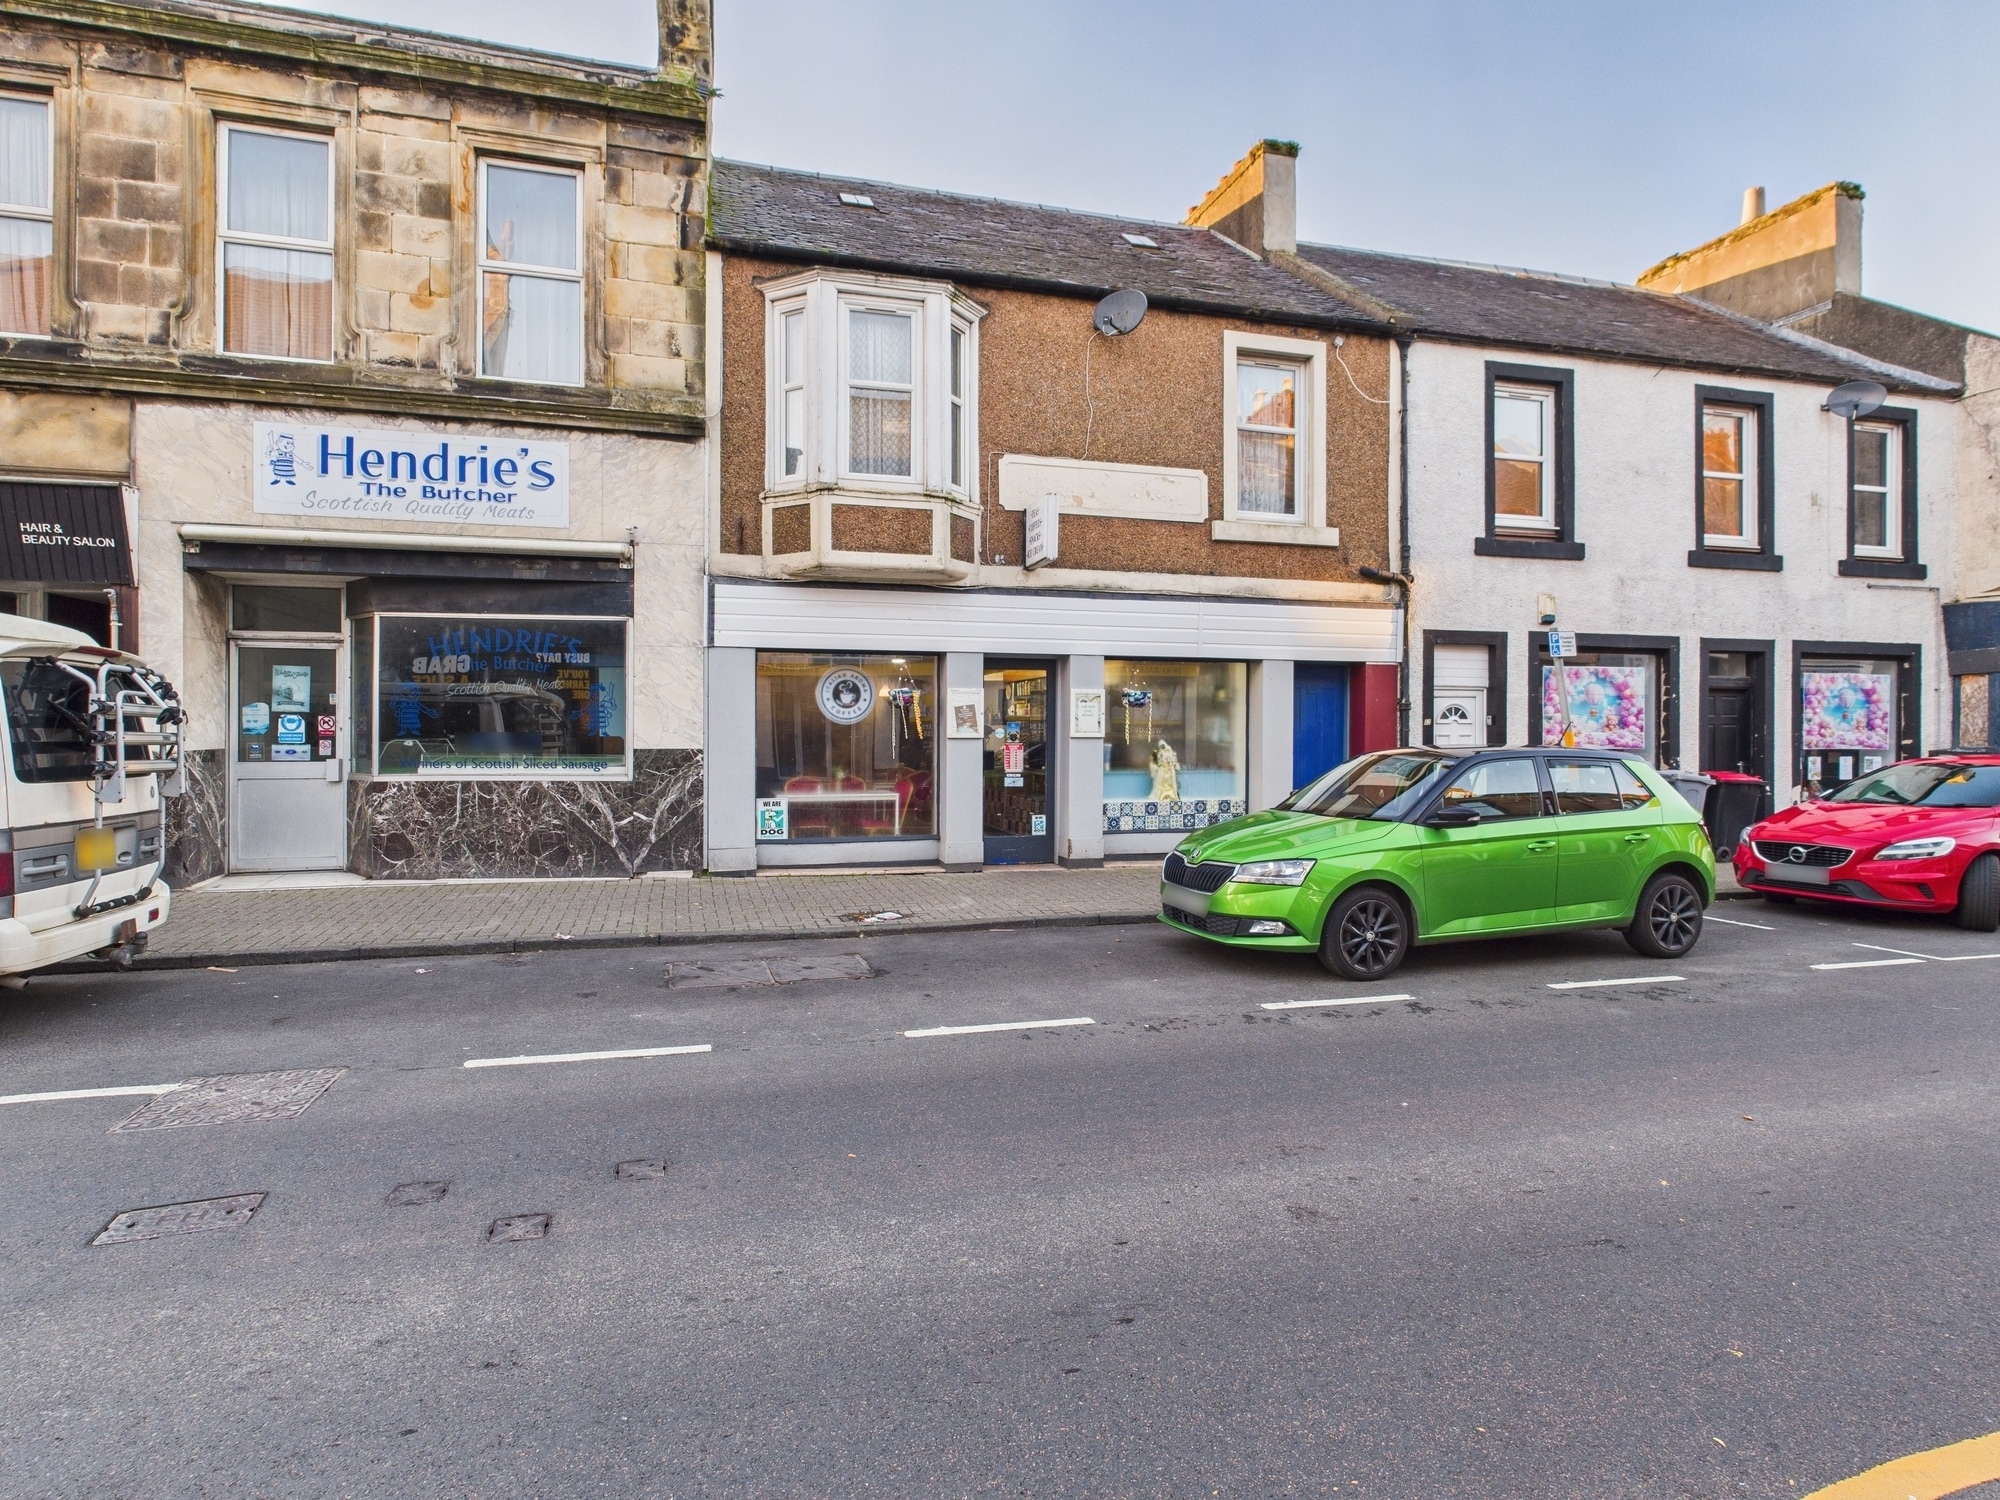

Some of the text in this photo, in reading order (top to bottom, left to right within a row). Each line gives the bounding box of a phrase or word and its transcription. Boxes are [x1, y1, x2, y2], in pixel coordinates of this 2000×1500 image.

[317, 433, 556, 489] Hendrie's
[358, 481, 518, 503] The Butcher
[301, 490, 535, 520] Scottish Quality Meats
[20, 522, 63, 534] HAIR &
[22, 534, 115, 548] BEAUTY SALON
[427, 627, 583, 657] HENDRIE'S
[1552, 634, 1558, 643] P
[493, 655, 550, 674] Butcher
[445, 676, 564, 698] Scottish Quality Meats
[825, 673, 868, 693] ITALIAN AROMA
[831, 705, 862, 716] COFFEE
[455, 756, 468, 769] of
[471, 757, 519, 769] Scottish
[523, 757, 557, 769] Sliced
[561, 758, 607, 772] Sausage
